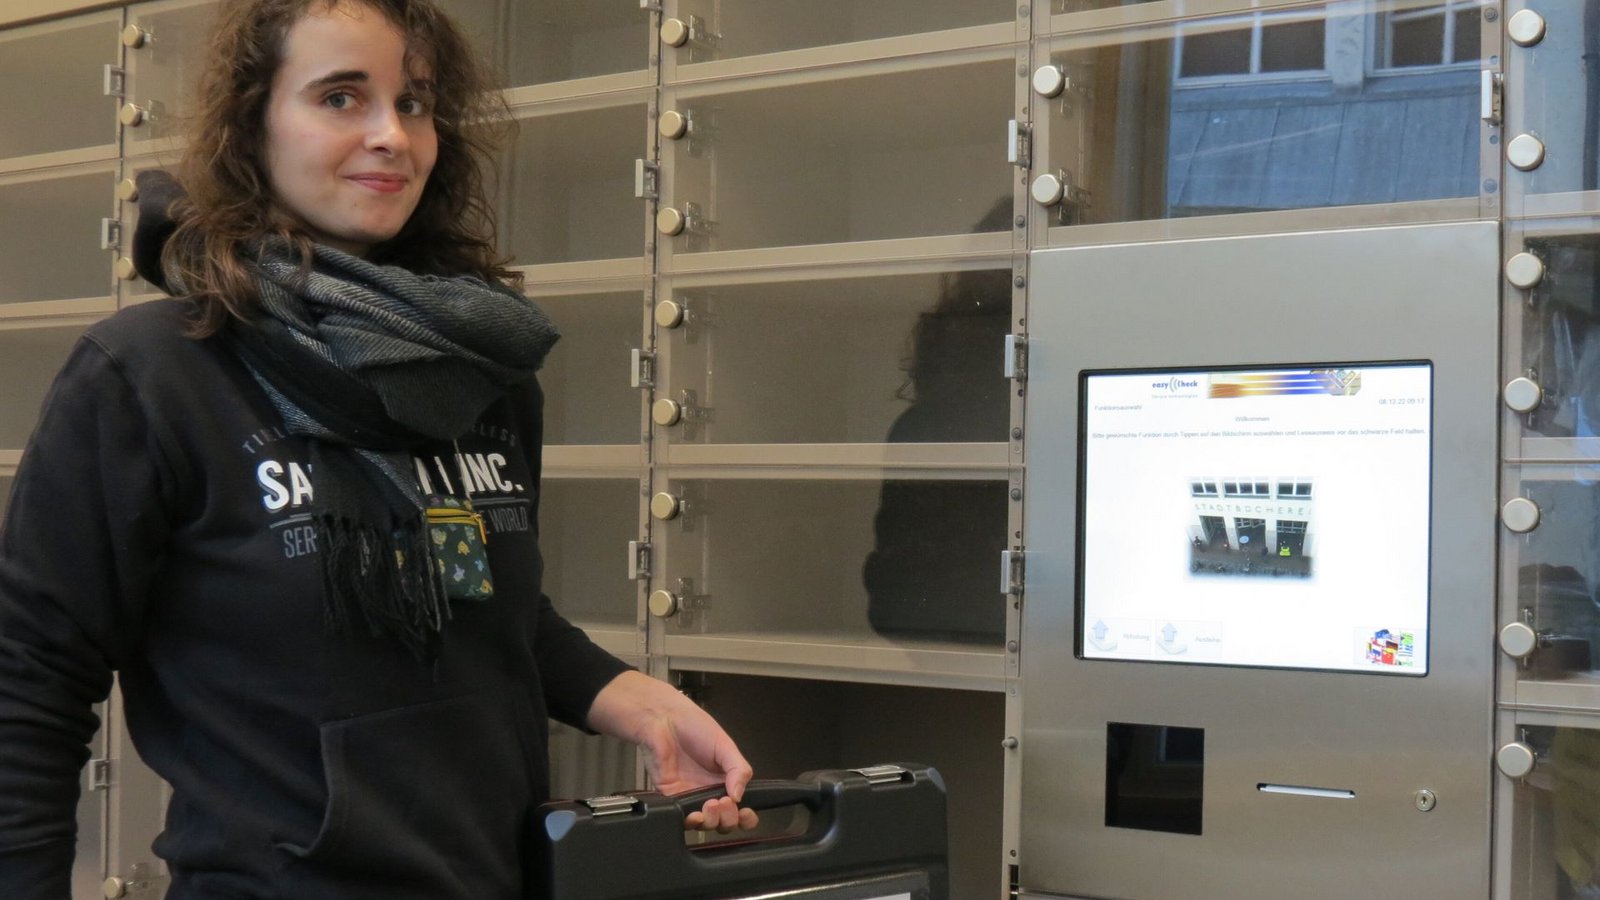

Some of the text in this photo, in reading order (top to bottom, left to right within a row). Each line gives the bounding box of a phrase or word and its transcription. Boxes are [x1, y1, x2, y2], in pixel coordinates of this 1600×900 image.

[1152, 382, 1168, 390] easy
[1180, 431, 1199, 439] Tippen
[283, 525, 319, 559] SER
[488, 506, 529, 533] WORLD
